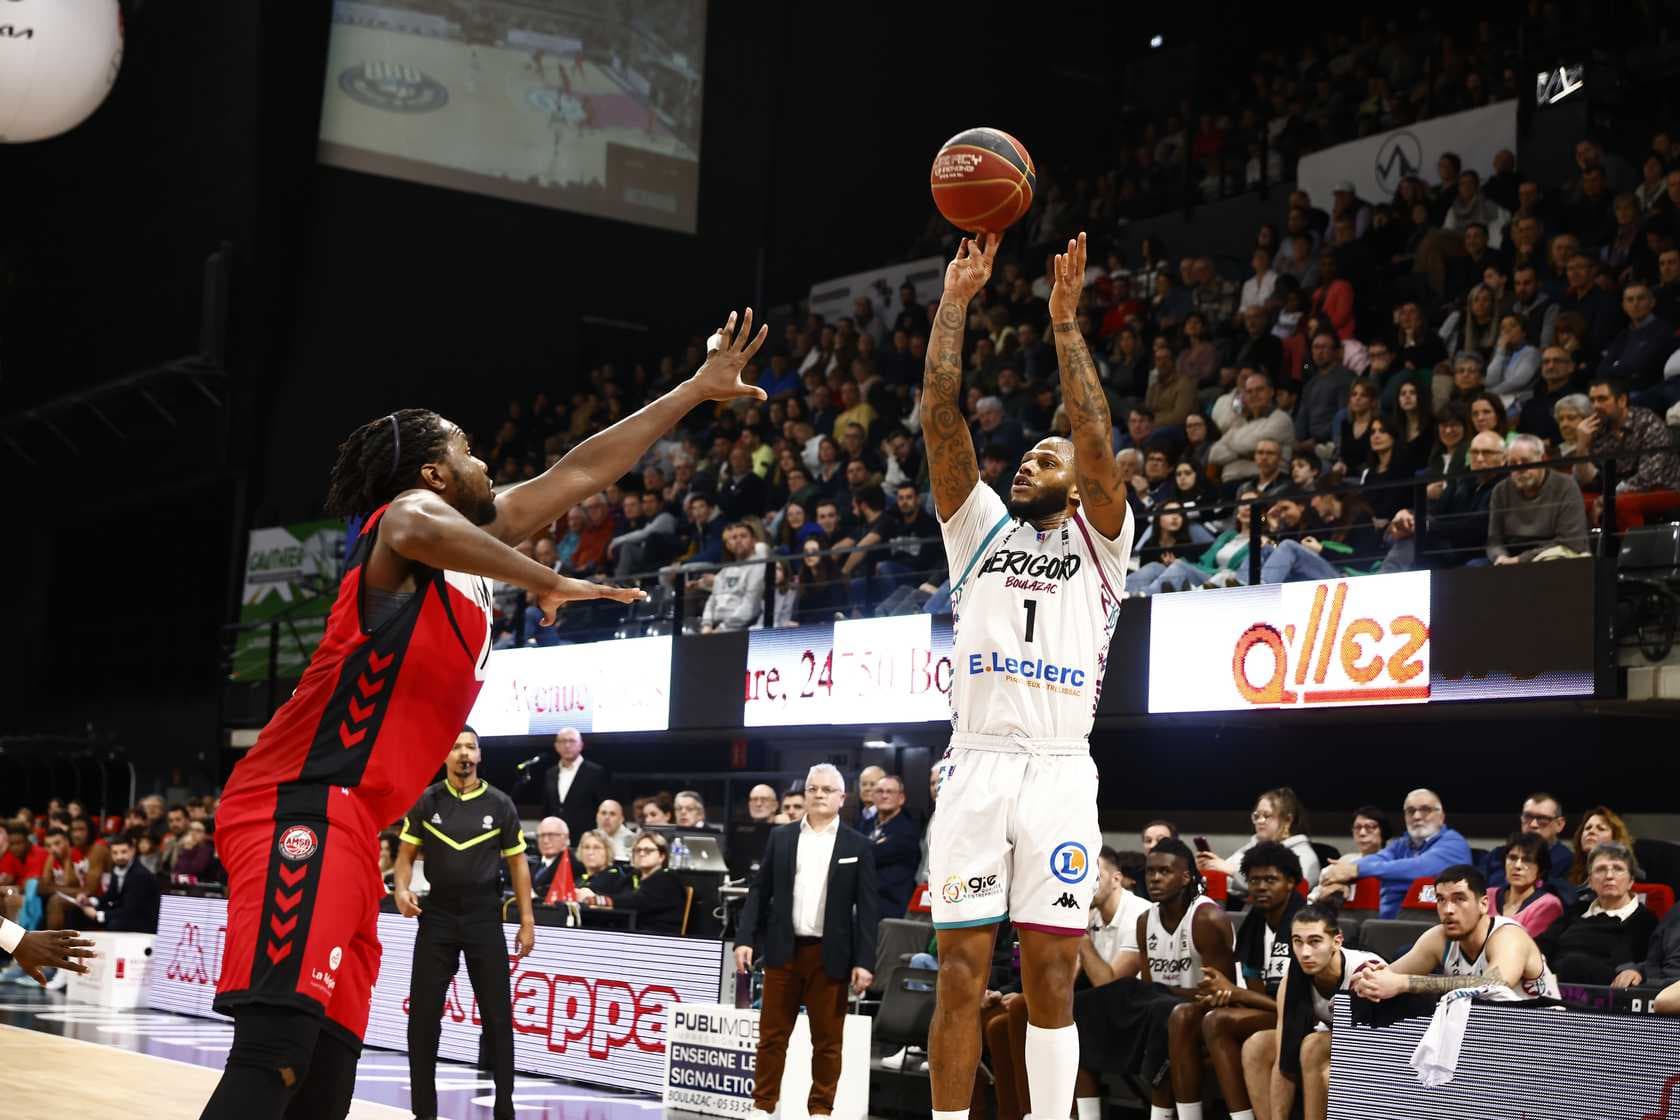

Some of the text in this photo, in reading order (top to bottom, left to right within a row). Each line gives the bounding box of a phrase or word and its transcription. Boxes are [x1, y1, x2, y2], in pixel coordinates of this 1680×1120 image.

[1005, 576, 1058, 594] BOULAZAC
[1023, 599, 1037, 643] 1
[969, 651, 1086, 687] E.Leclerc
[968, 874, 998, 894] gie
[1274, 943, 1290, 956] 23
[671, 1045, 736, 1069] ENSEIGNE
[669, 1090, 711, 1108] BOULAZAC
[717, 1098, 728, 1110] 05
[729, 1100, 740, 1112] 53
